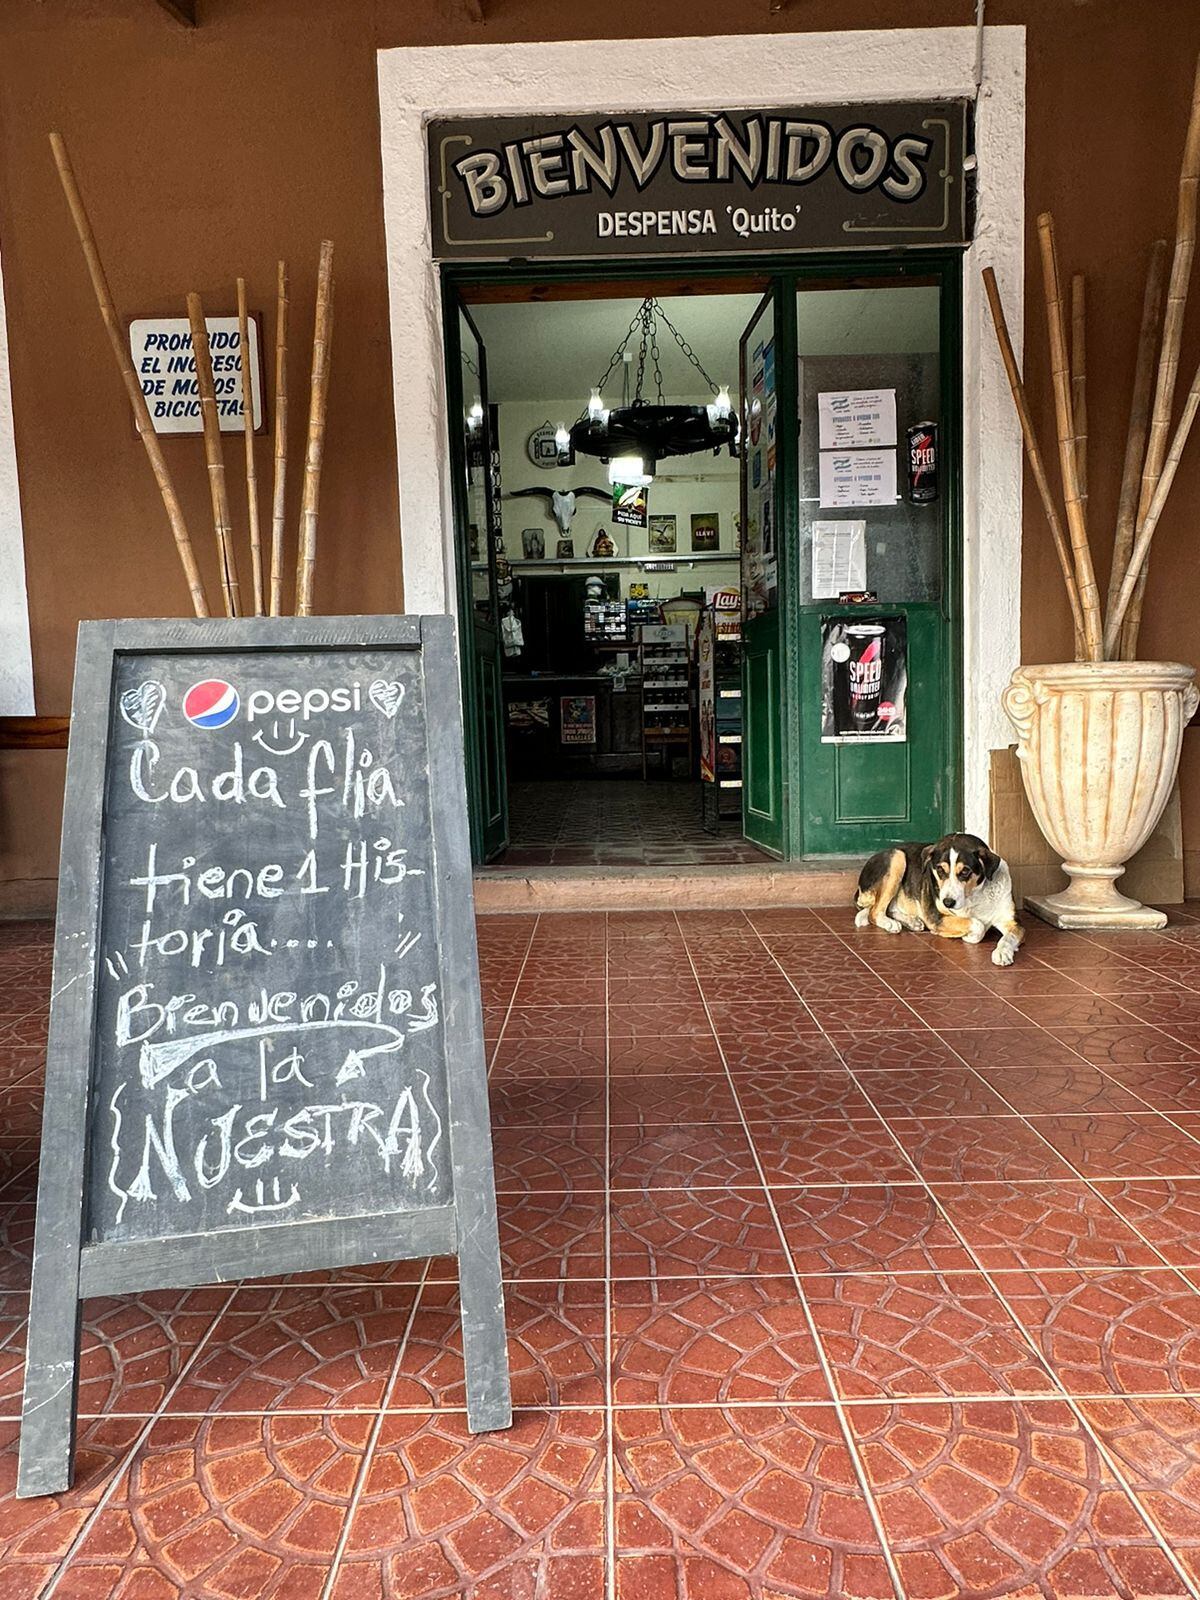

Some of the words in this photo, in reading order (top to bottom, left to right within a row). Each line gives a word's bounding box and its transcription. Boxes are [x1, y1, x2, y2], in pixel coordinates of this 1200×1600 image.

[456, 116, 931, 217] BIENVENIDOS
[598, 208, 717, 238] DESPENSA
[144, 332, 241, 351] PROHIDO
[141, 357, 161, 374] EL
[167, 355, 243, 374] INGESO
[142, 379, 166, 397] DE
[172, 378, 236, 396] MOOS
[154, 399, 246, 418] BICICTAS
[911, 448, 935, 465] SPEED
[849, 659, 882, 683] SPEED
[247, 682, 362, 722] pepsi
[130, 740, 286, 808] Cada
[298, 728, 406, 840] flia
[130, 842, 285, 912] tiene
[296, 849, 329, 894] 1
[185, 1058, 223, 1094] a
[259, 1038, 314, 1102] la
[126, 1086, 425, 1203] NUESTRA
